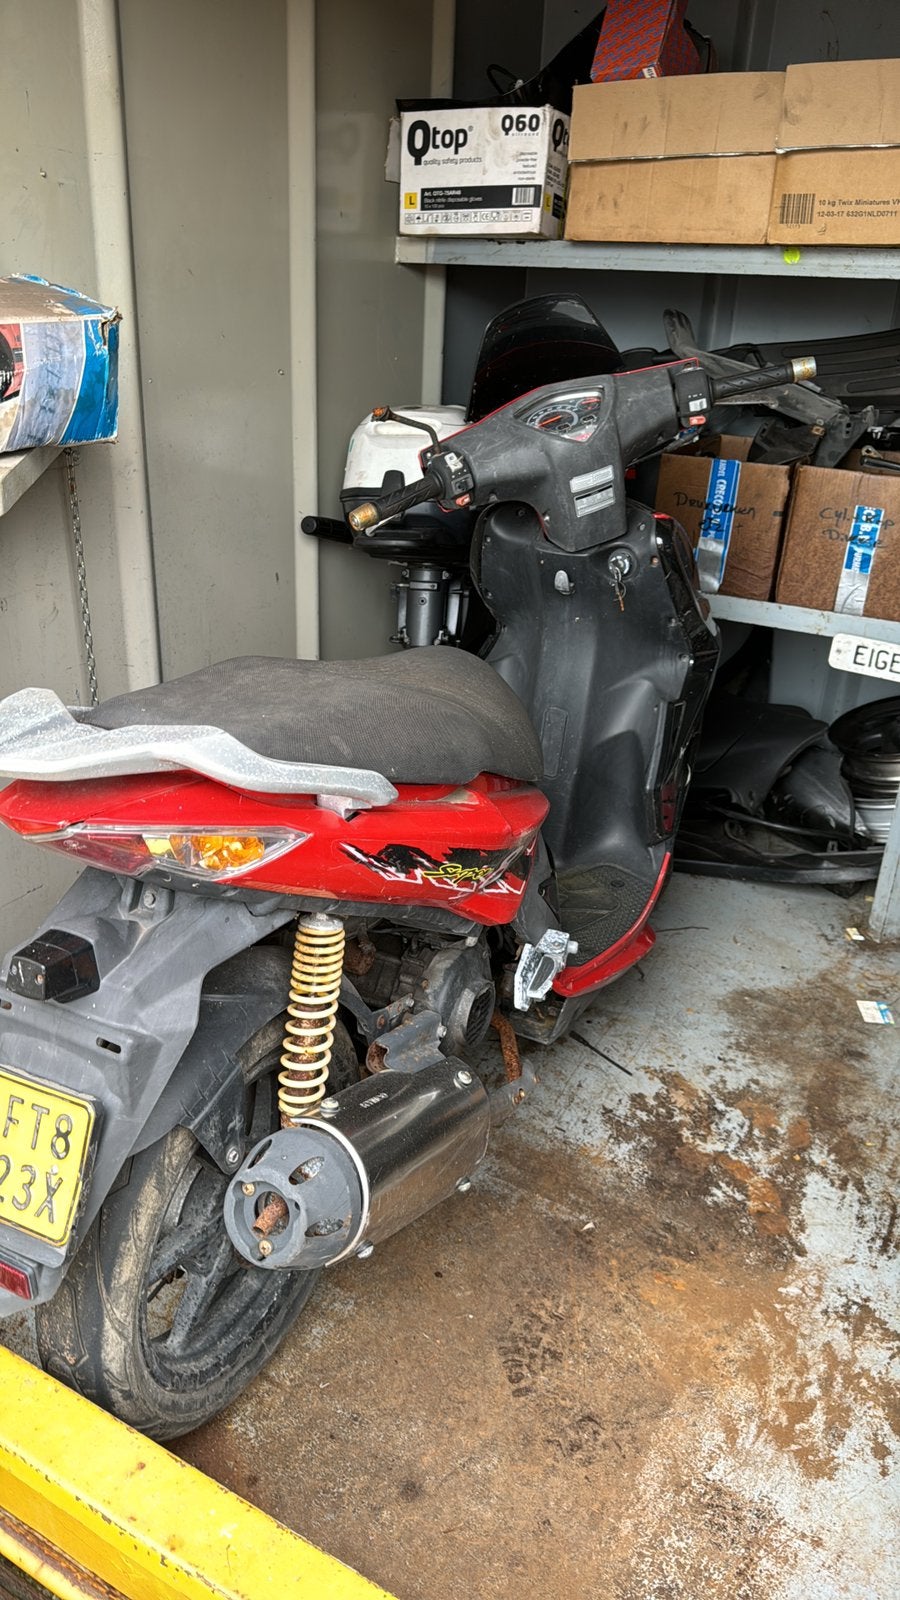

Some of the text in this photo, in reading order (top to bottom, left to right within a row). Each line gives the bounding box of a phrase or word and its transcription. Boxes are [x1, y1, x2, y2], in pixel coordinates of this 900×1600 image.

[501, 114, 540, 136] Q60
[407, 120, 468, 166] Qtop
[423, 156, 482, 166] quality safety products
[409, 196, 415, 206] L
[853, 645, 900, 674] EIGE
[3, 1095, 72, 1160] FT8
